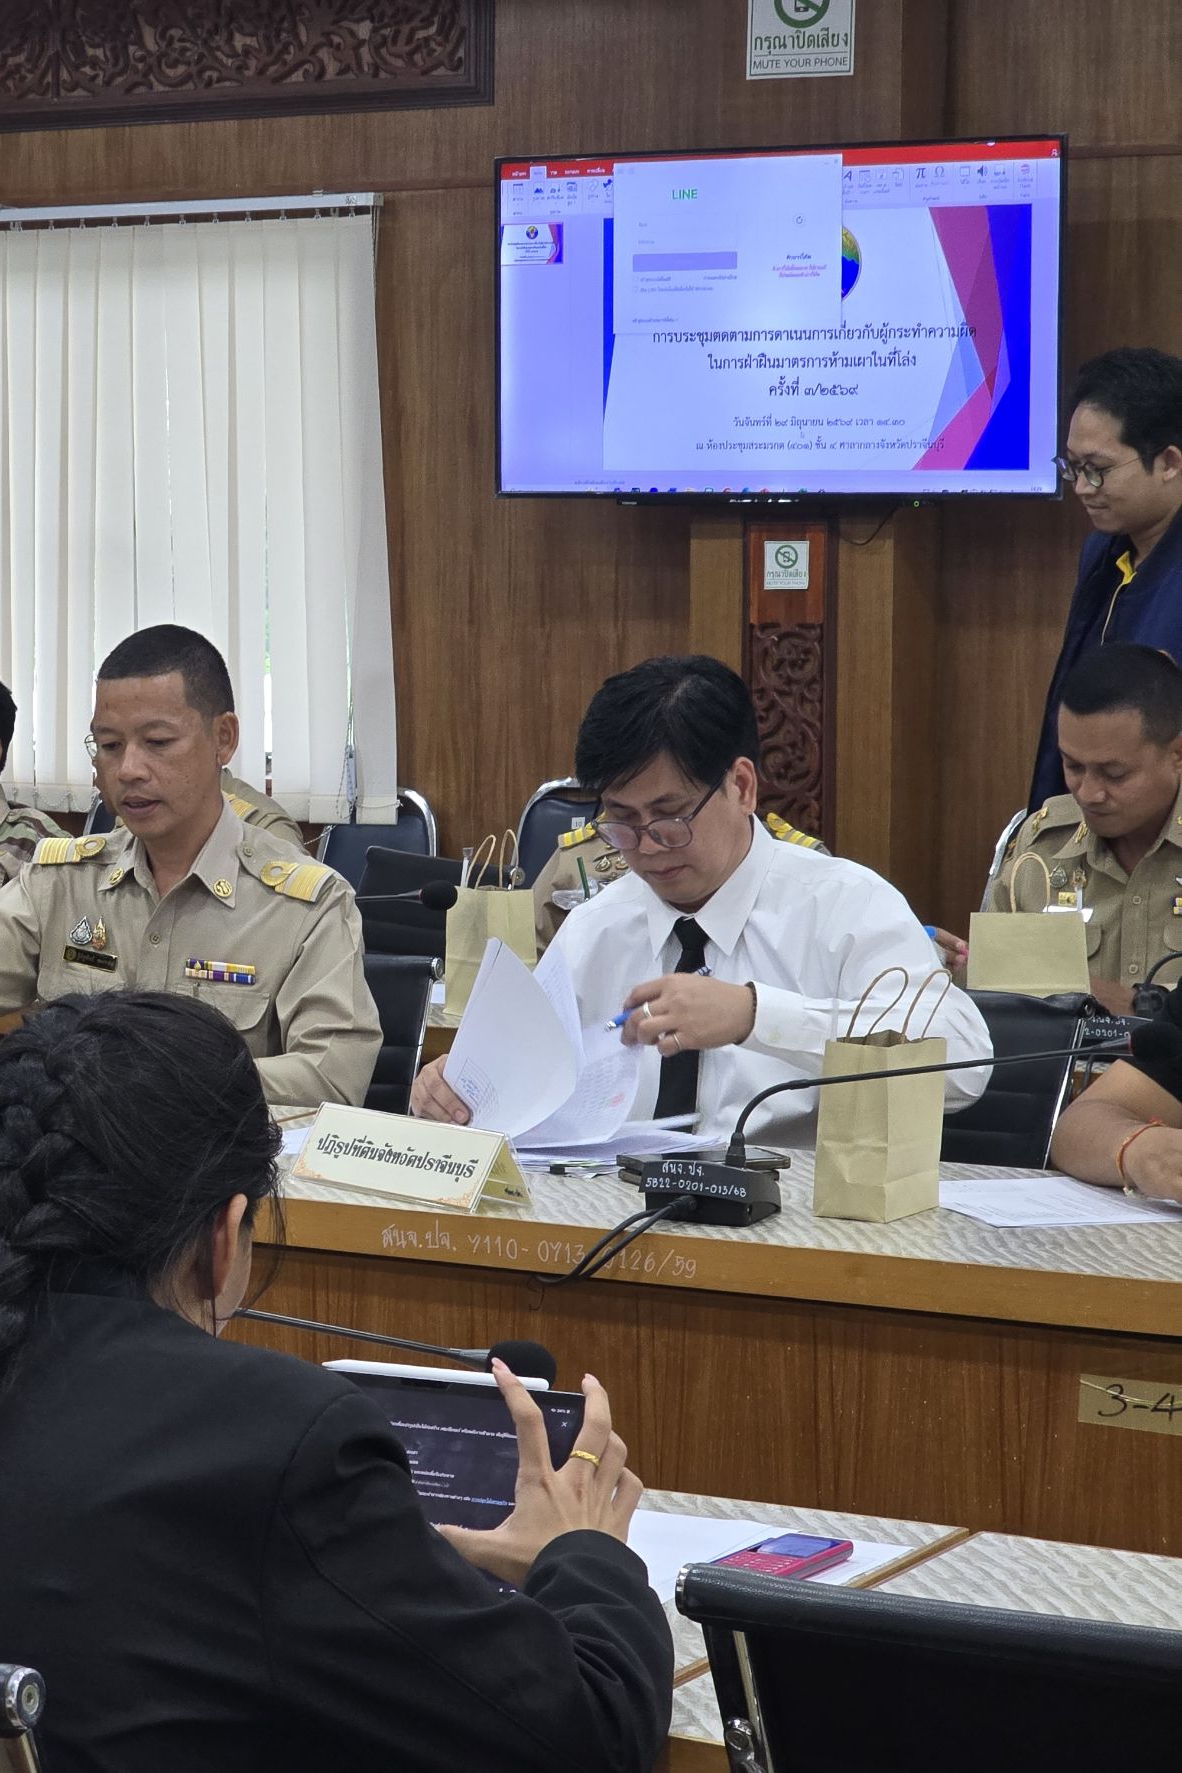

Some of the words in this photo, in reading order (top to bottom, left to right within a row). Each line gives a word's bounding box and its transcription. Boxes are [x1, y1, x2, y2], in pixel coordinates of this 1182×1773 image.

[754, 27, 849, 55] กรุณาปิดเสียง
[753, 59, 780, 70] MUTE
[784, 58, 811, 69] YOUR
[814, 56, 848, 67] PHONE
[671, 188, 698, 200] LINE
[769, 375, 799, 396] ครั้งที่
[316, 1134, 479, 1183] ปฏิรูปที่ดินจังหวัดปราจีนบุรี
[645, 1177, 747, 1198] 5822-0201-013/68
